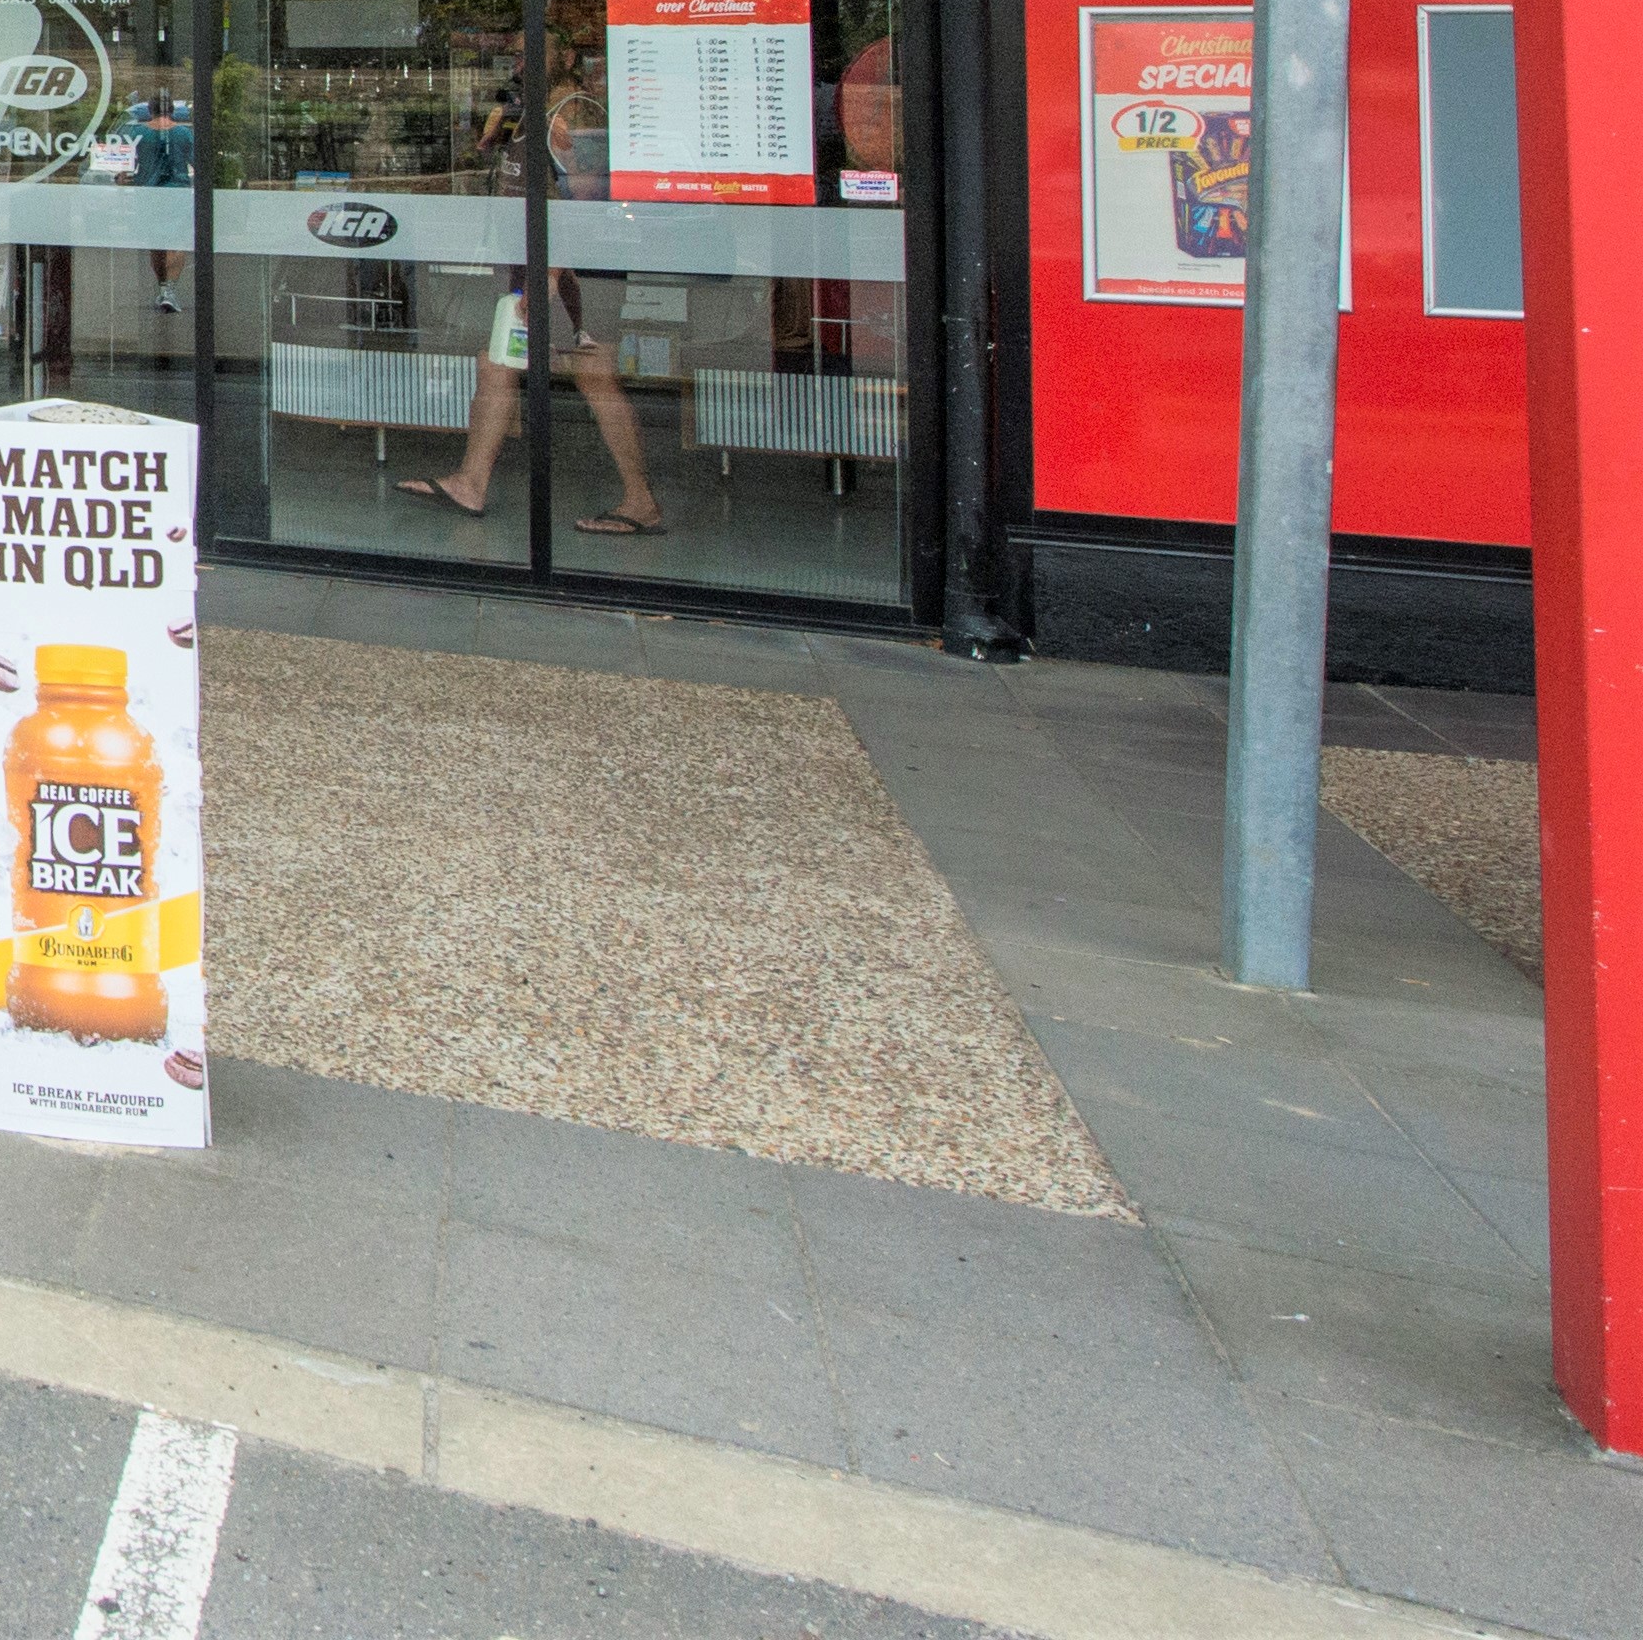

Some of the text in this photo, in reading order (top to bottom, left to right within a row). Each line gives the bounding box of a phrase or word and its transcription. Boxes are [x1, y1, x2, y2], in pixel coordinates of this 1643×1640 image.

[655, 1, 685, 13] over
[1160, 34, 1253, 57] Christma
[1135, 109, 1177, 135] 1/2
[1135, 136, 1181, 149] PRICE
[317, 210, 388, 238] IGA
[1137, 284, 1175, 295] Specials
[1177, 287, 1196, 295] end
[1198, 288, 1220, 297] 24th
[2, 494, 153, 541] MADE
[63, 545, 164, 591] QLD
[39, 783, 132, 806] REAL COFFEE
[30, 802, 142, 868] ICE
[31, 861, 144, 897] BREAK
[38, 935, 133, 963] BUNDABERG
[76, 959, 98, 967] RUM
[12, 1082, 165, 1108] ICE BREAK FLAVOURED
[28, 1097, 149, 1118] WITH BUNDABERG RUM
